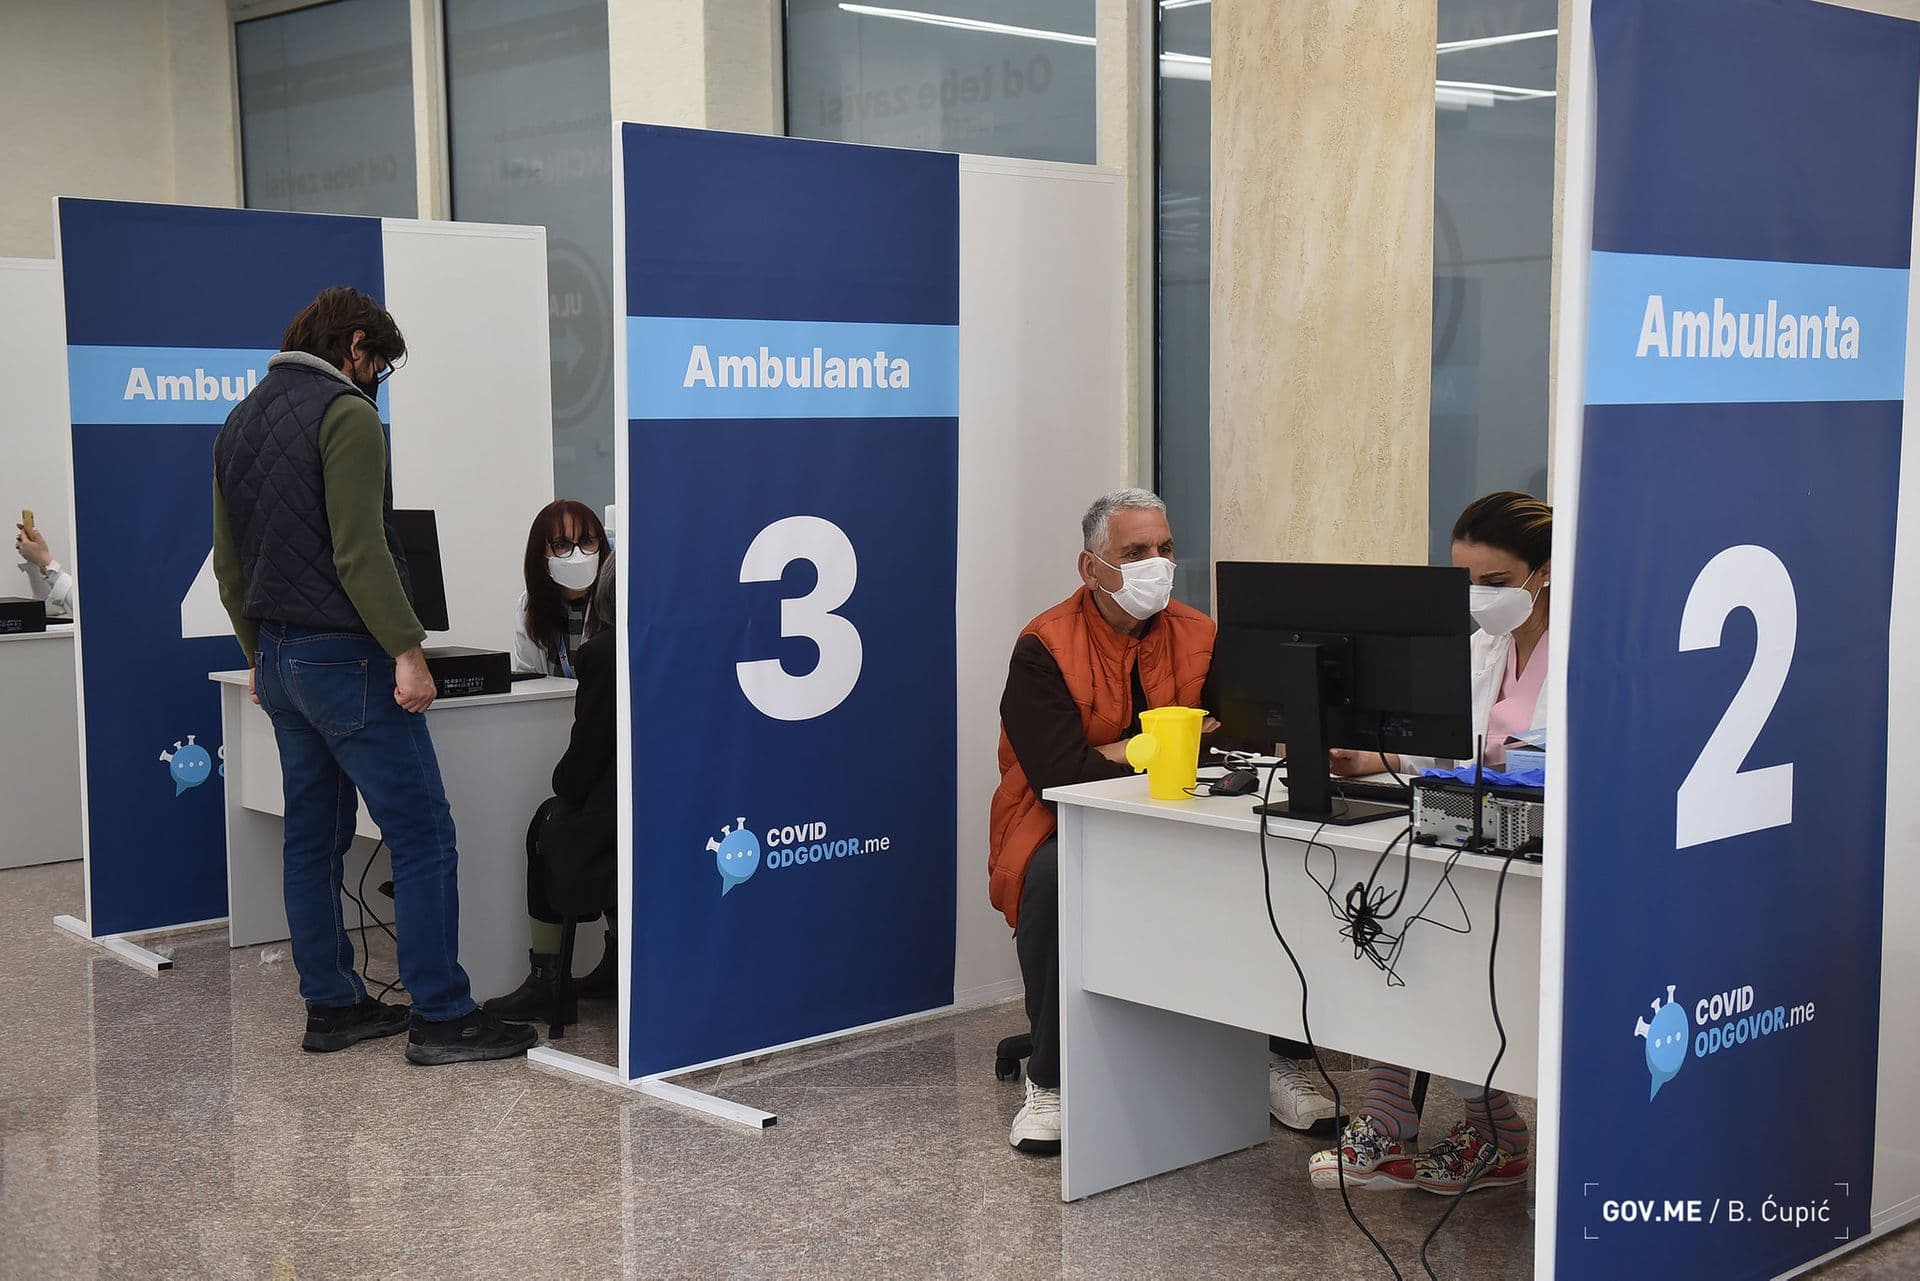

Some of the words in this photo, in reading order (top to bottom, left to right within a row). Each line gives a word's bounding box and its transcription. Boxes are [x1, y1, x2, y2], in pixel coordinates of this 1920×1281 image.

[1636, 295, 1859, 359] Ambulanta
[123, 367, 257, 401] Ambul
[683, 345, 911, 388] Ambulanta
[735, 515, 863, 721] 3
[1676, 544, 1797, 849] 2
[766, 821, 827, 847] COVID
[766, 836, 890, 869] ODGOVOR.me
[1695, 985, 1754, 1025] COVID
[1695, 1002, 1815, 1057] ODGOVOR.me
